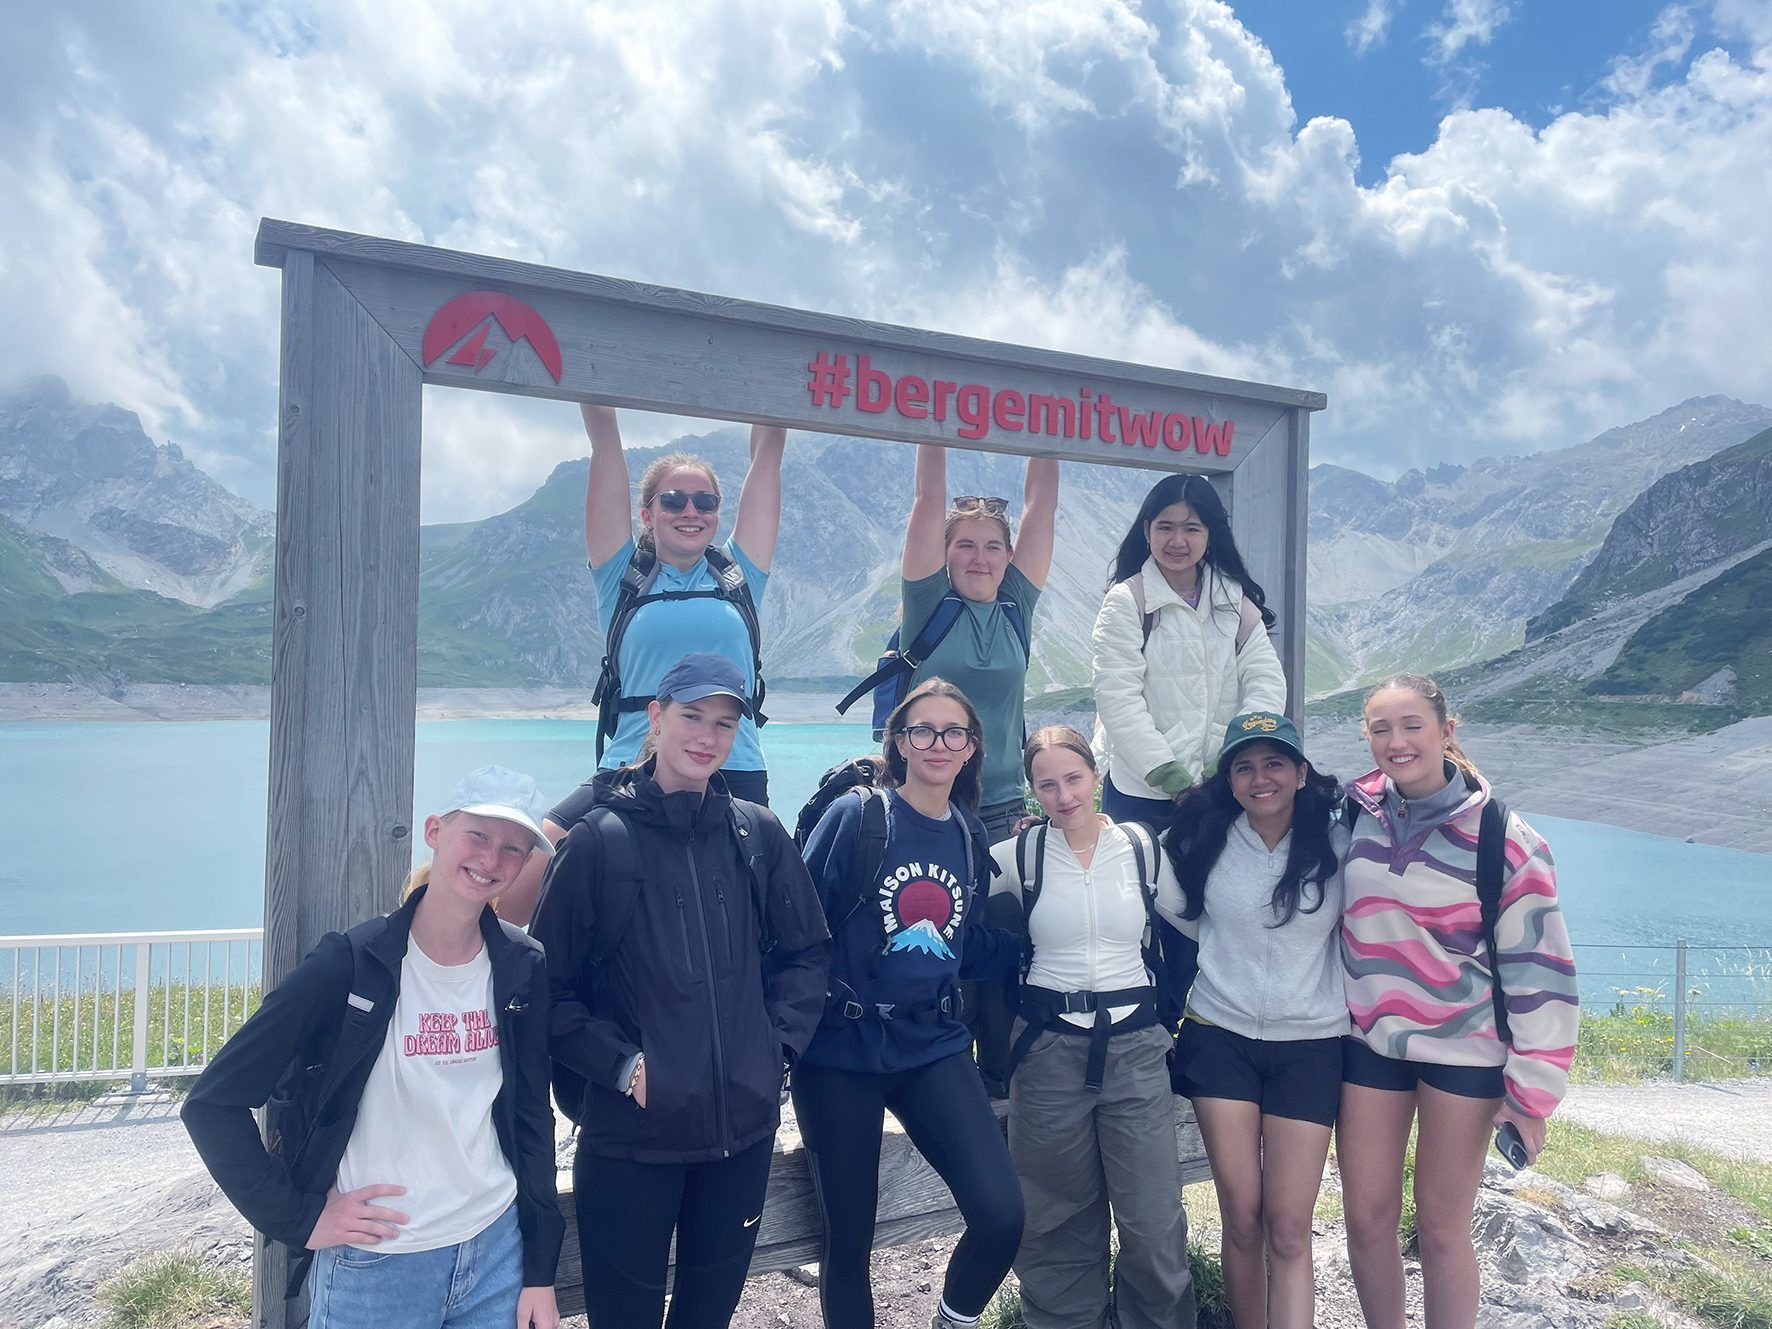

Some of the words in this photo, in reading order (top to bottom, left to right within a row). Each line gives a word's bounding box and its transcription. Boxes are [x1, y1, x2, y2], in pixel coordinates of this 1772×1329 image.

[808, 351, 1235, 456] #bergemitwow
[879, 862, 923, 934] MAISON
[404, 1033, 460, 1056] DREAM
[419, 1013, 458, 1032] KEEP
